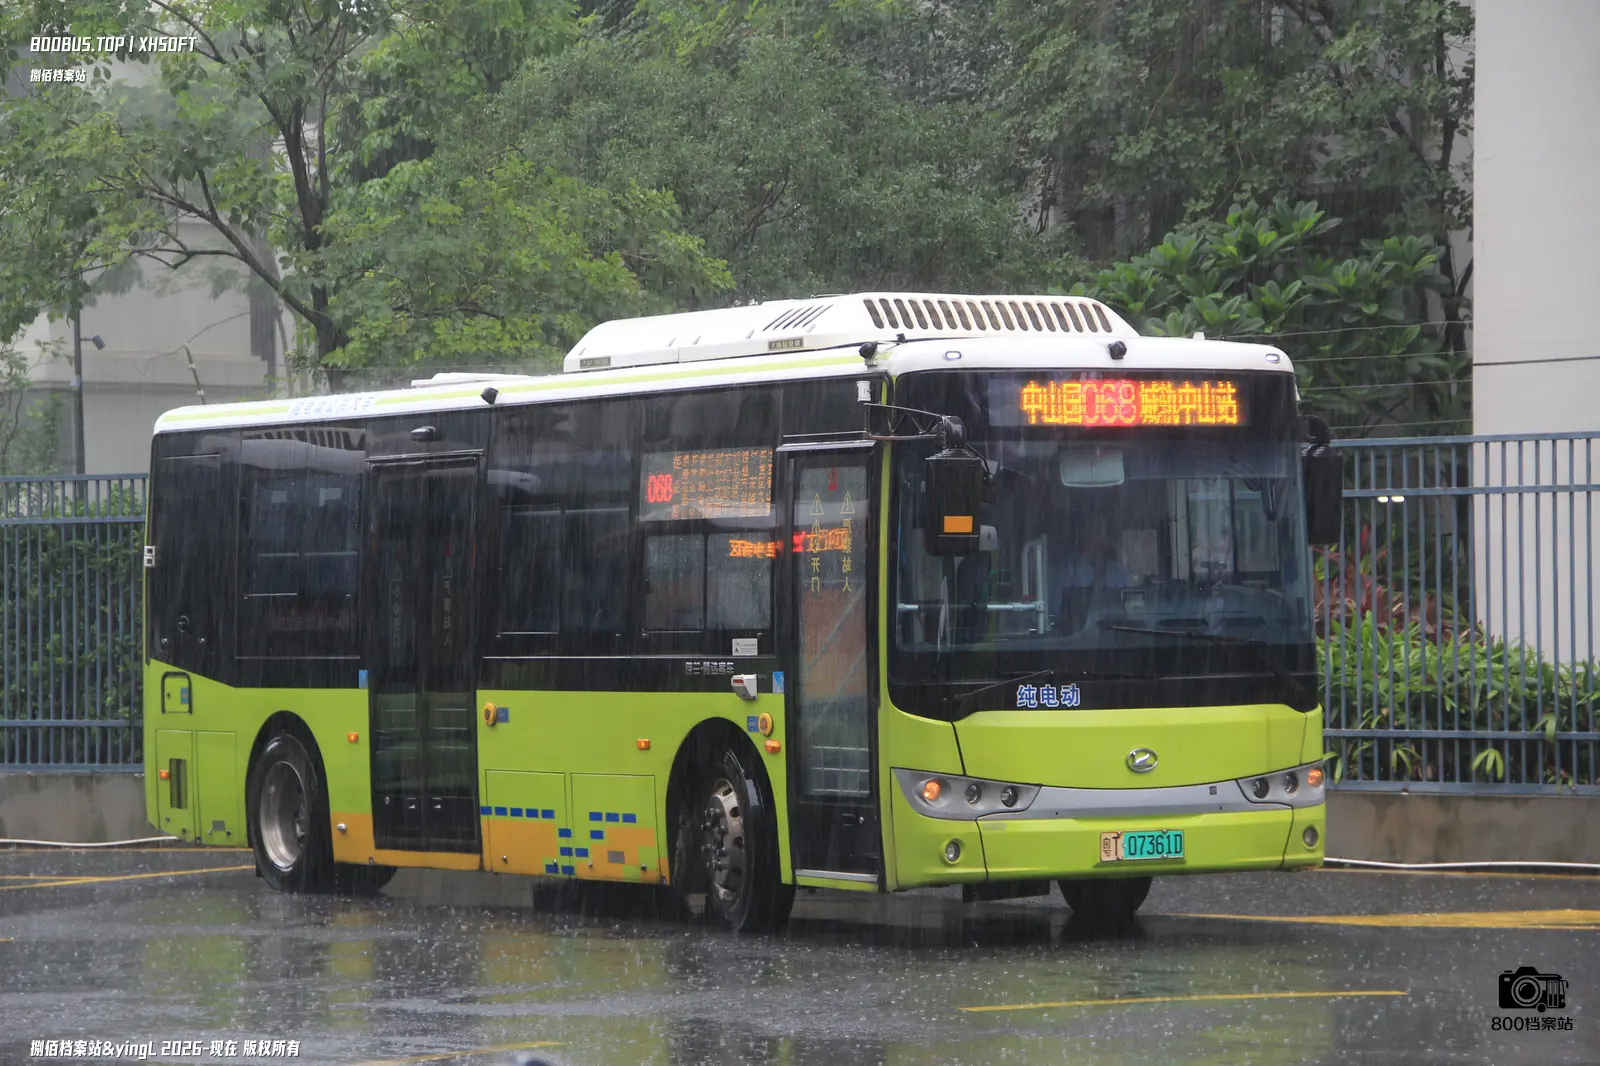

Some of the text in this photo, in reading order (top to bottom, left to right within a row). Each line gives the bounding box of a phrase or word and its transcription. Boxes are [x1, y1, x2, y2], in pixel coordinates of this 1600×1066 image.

[647, 473, 673, 503] 068
[1016, 683, 1081, 708] 纯电动
